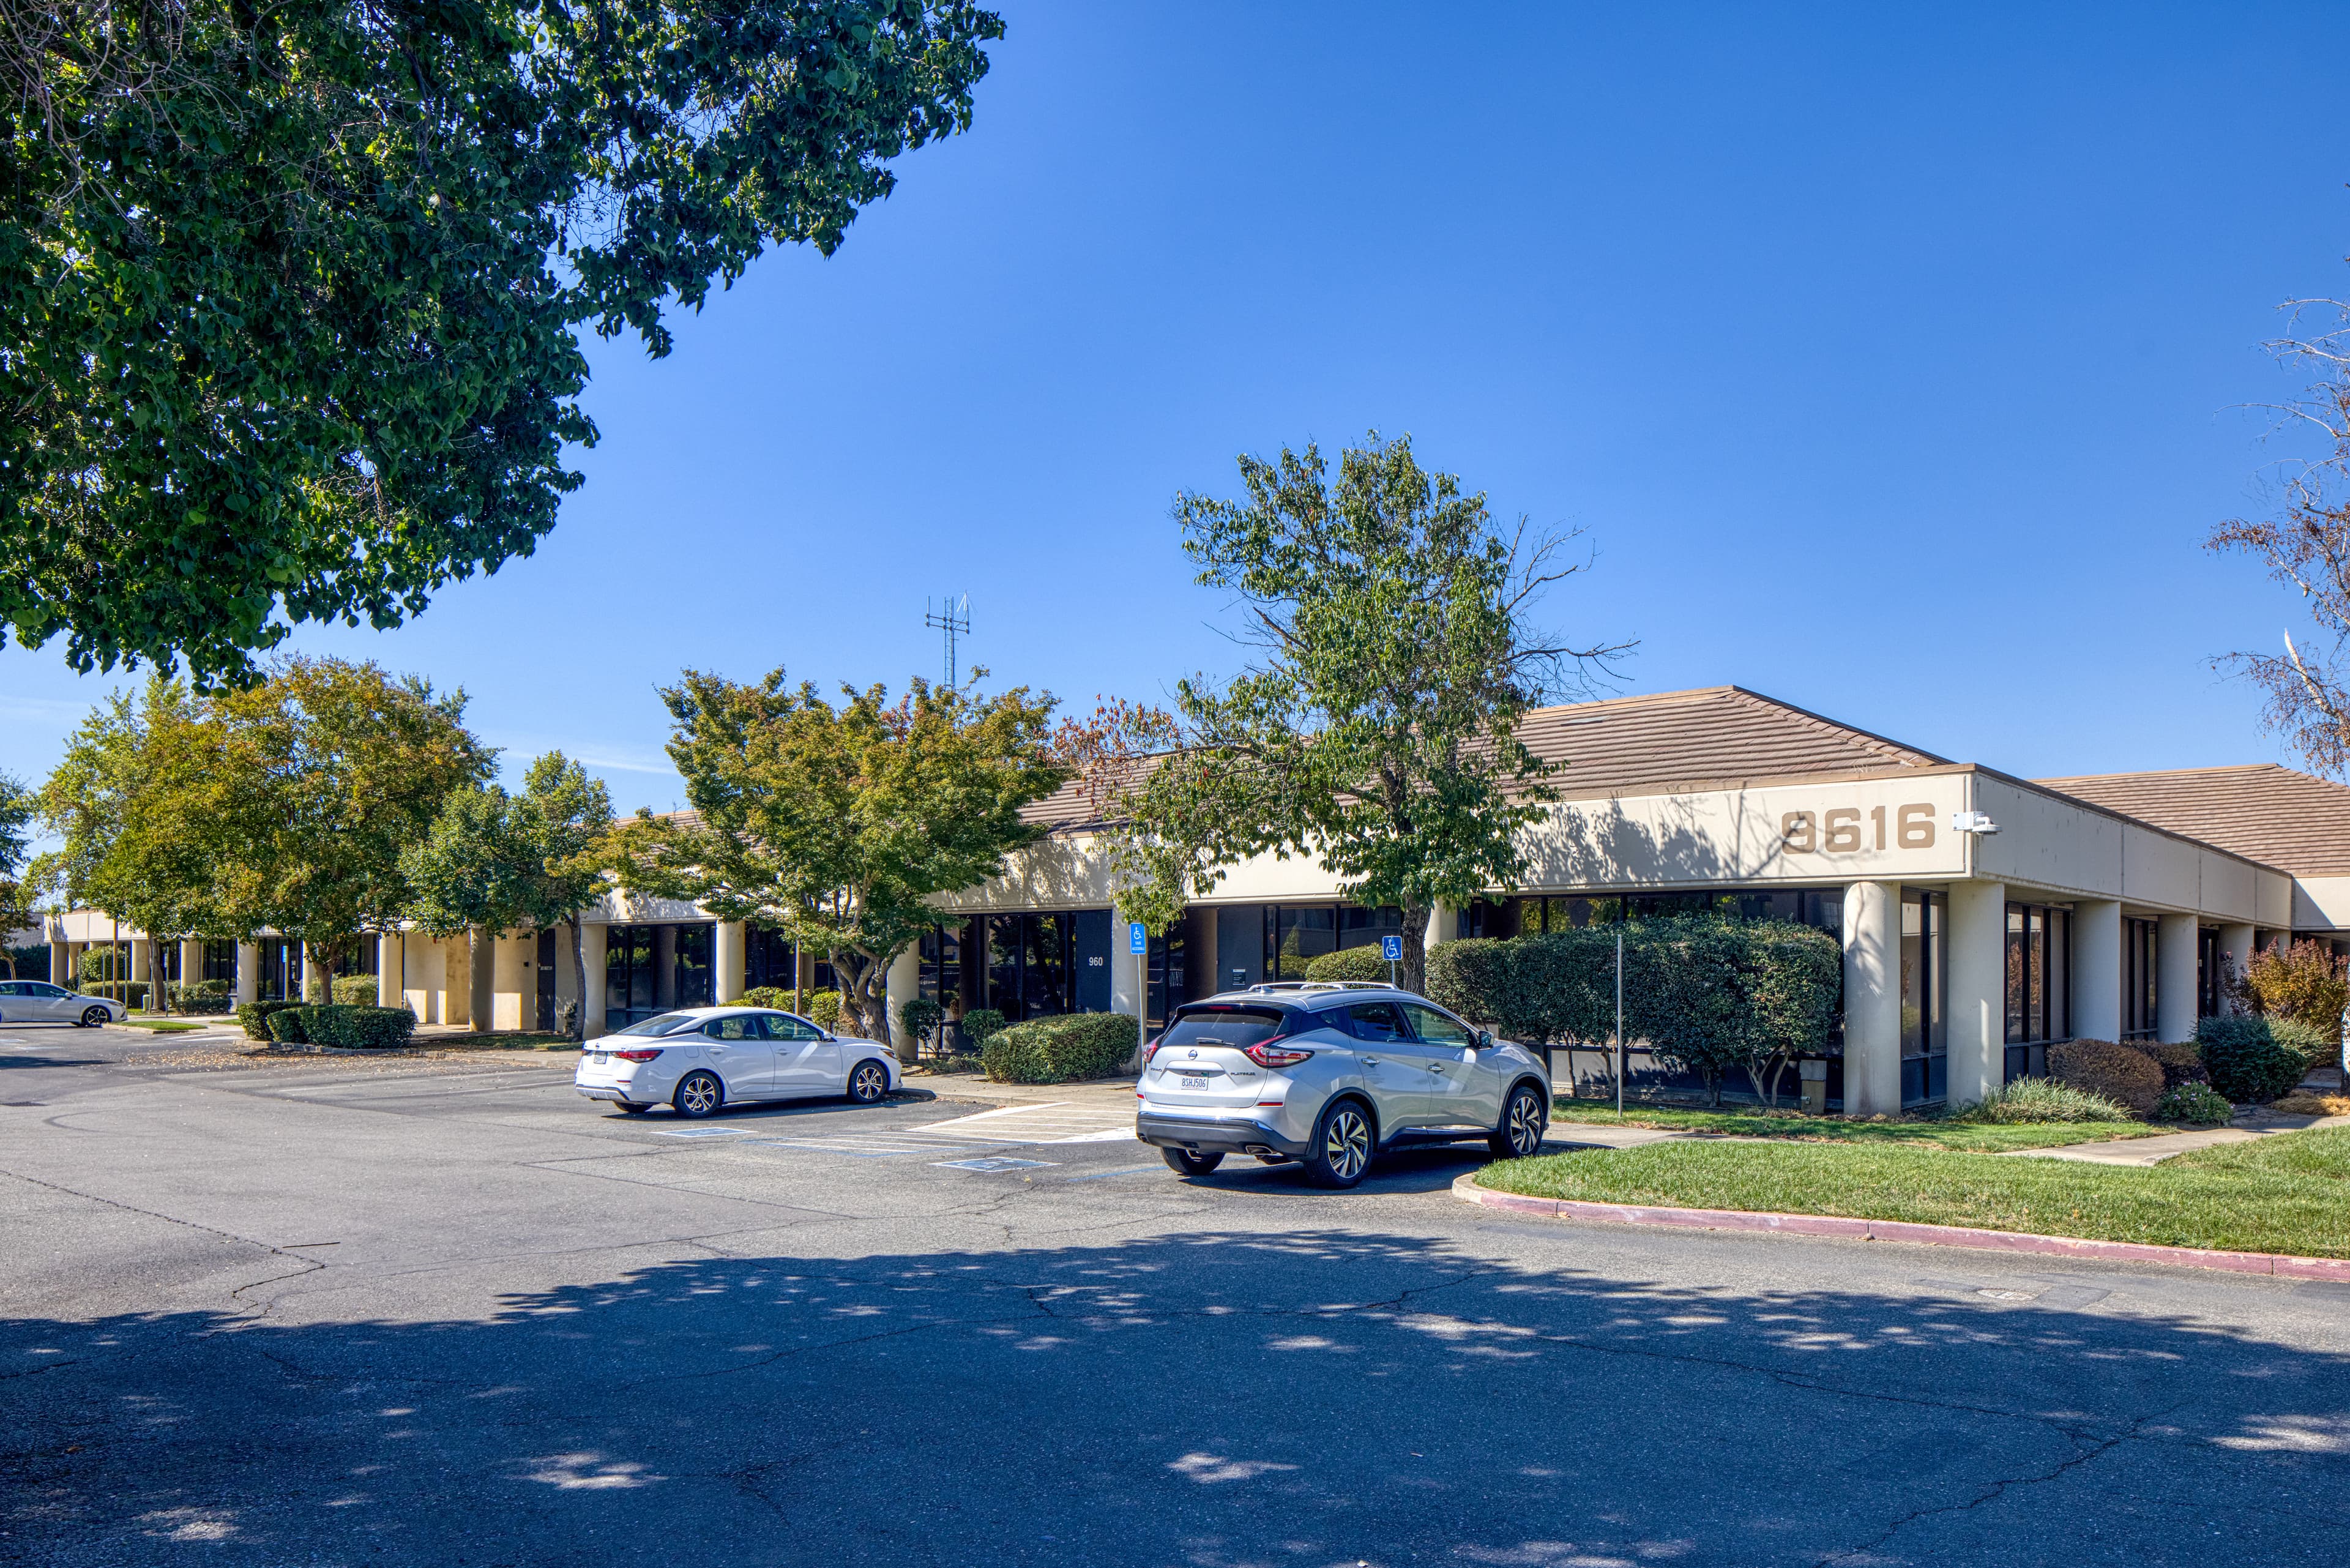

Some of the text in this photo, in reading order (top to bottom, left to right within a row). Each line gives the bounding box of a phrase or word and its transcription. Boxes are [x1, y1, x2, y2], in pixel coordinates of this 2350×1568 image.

[1781, 803, 1935, 854] 9616
[1089, 957, 1103, 966] 960
[1182, 1078, 1206, 1088] 8SHJ506
